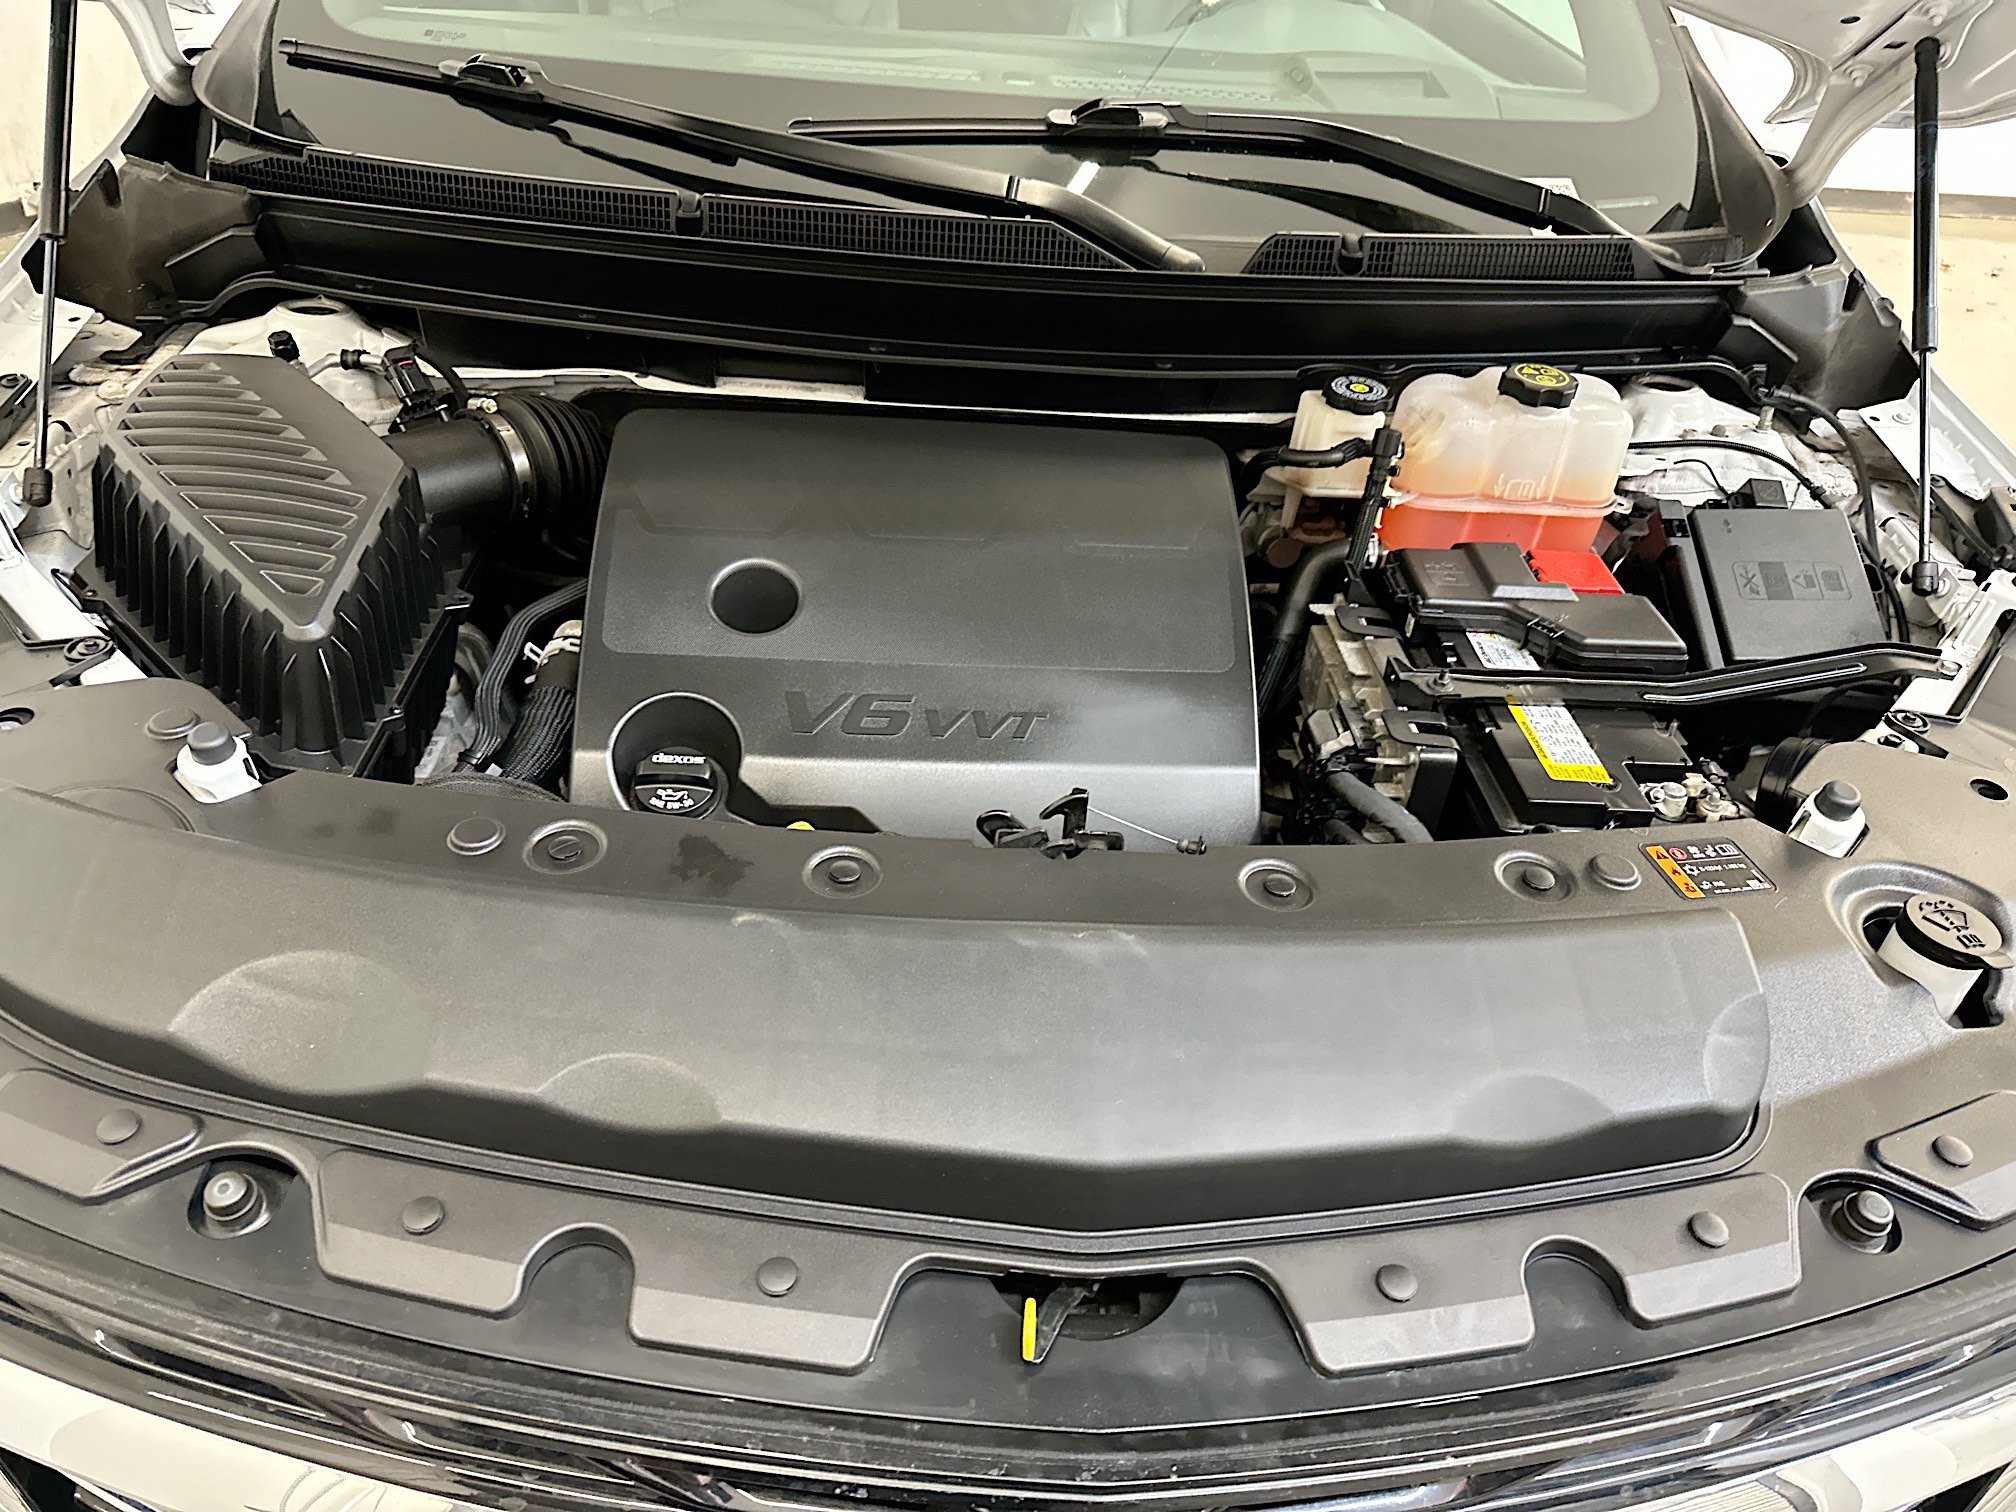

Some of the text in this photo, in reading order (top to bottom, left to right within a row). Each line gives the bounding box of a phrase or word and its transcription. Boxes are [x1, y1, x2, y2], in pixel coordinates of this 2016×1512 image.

[784, 690, 1049, 741] V6 VVT
[651, 752, 707, 764] dexos
